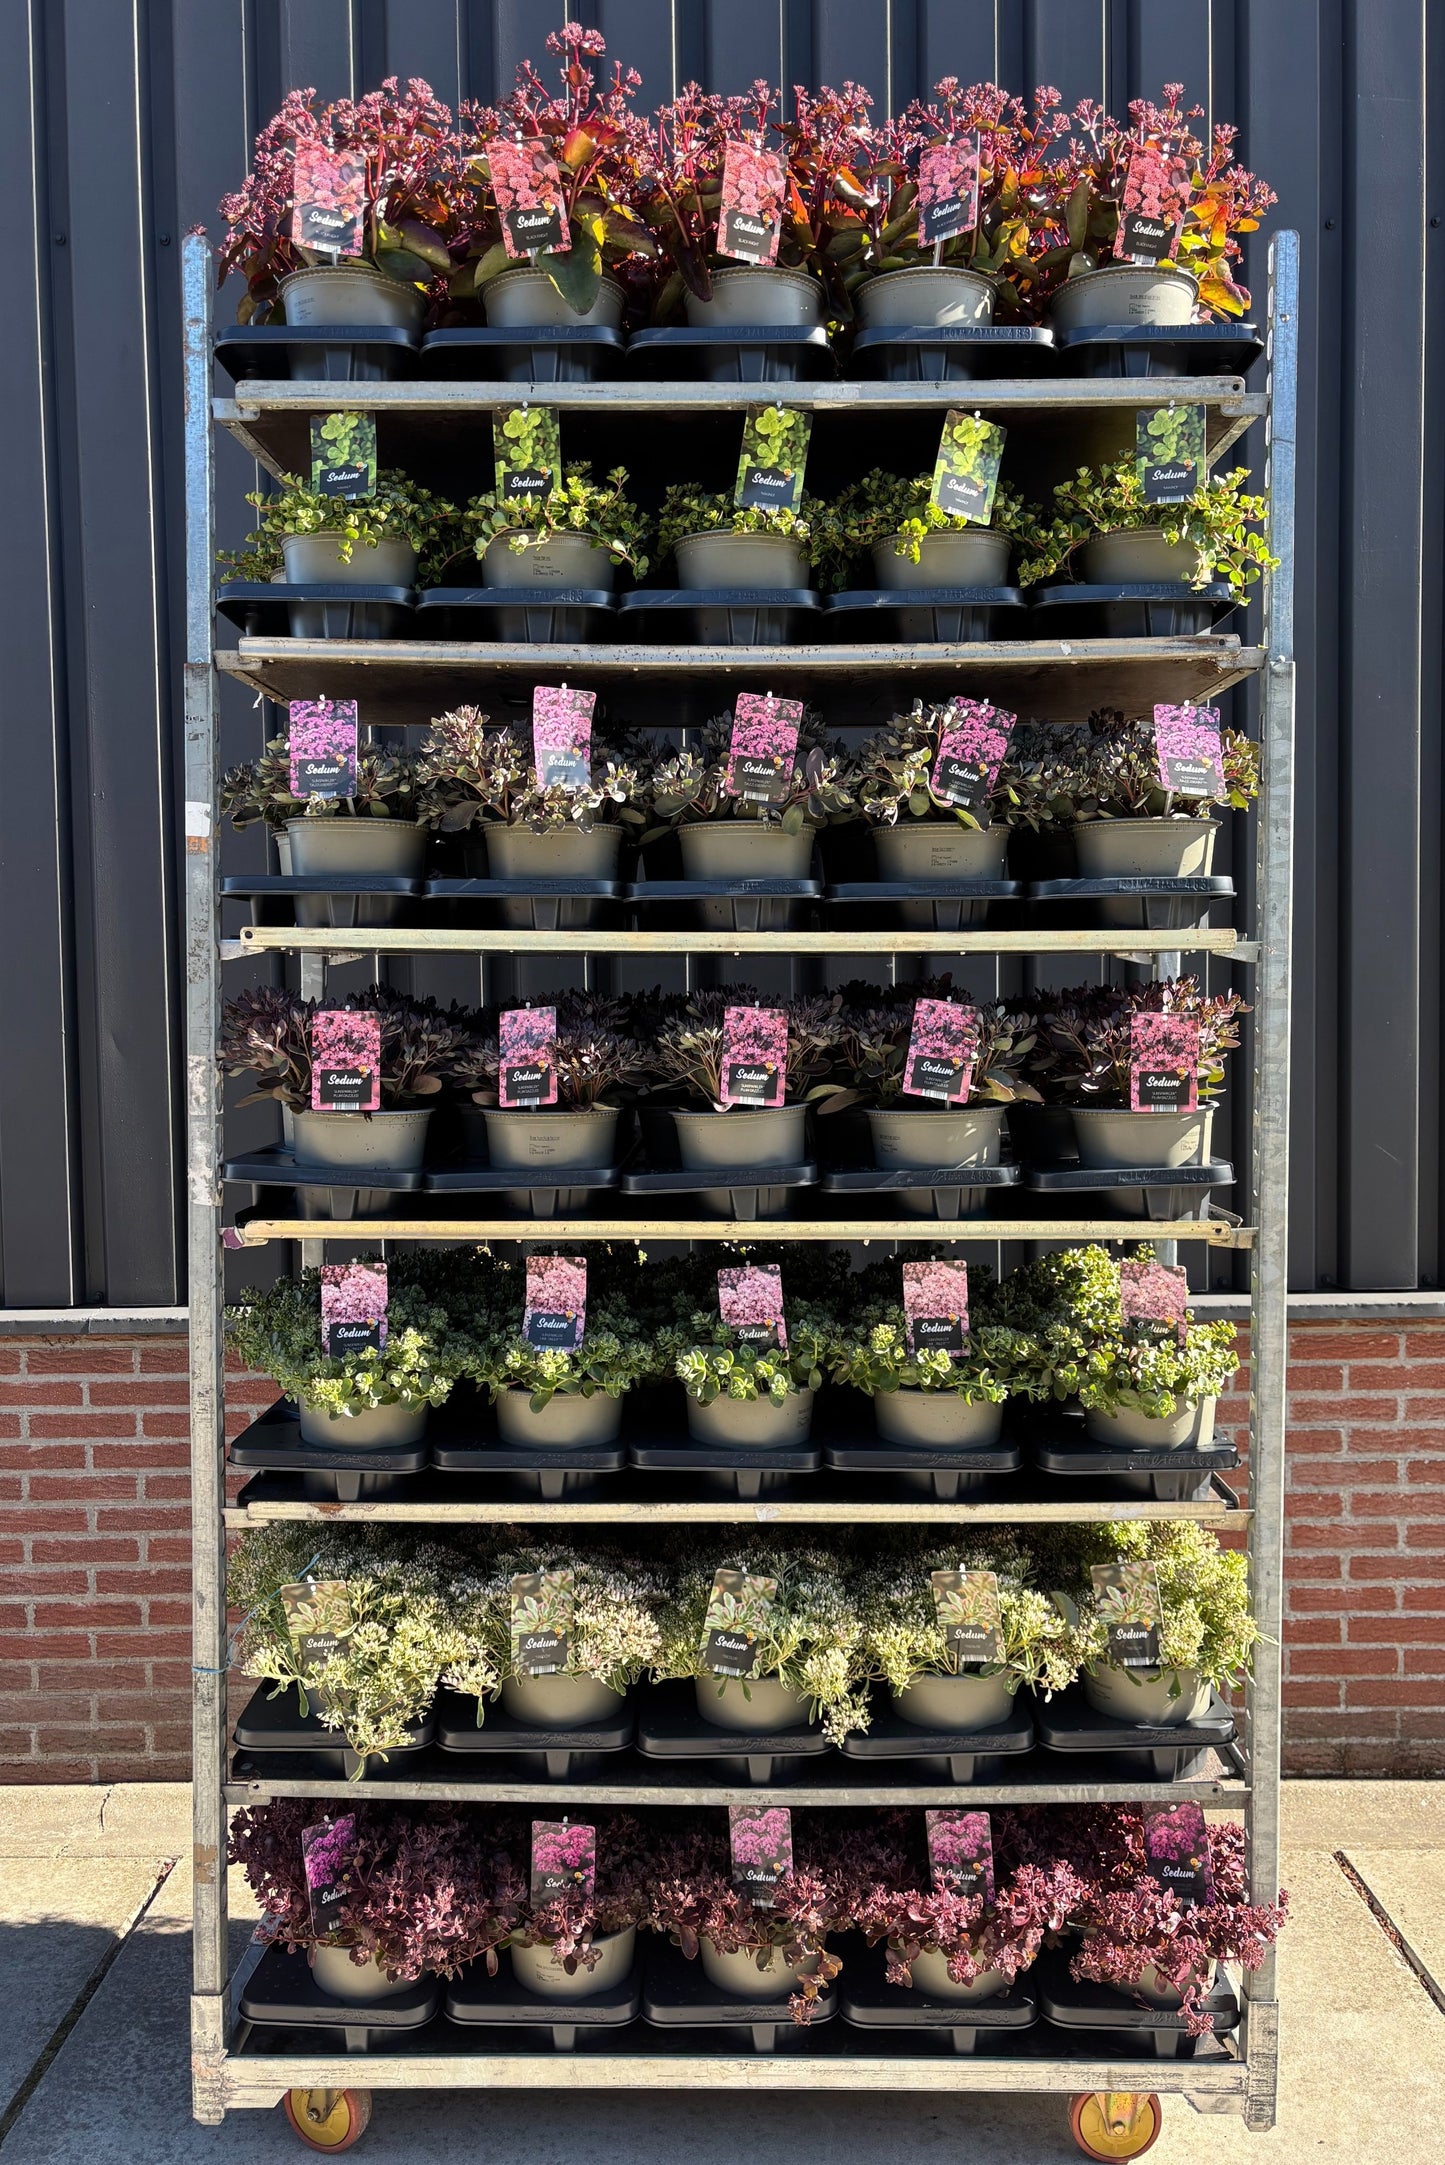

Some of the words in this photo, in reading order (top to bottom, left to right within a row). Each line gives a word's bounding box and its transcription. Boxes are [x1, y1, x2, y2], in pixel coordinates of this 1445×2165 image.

[931, 202, 962, 219] Sedum
[309, 211, 347, 229] Sedum
[516, 214, 551, 229] Sedum
[733, 218, 766, 236] Sedum
[1132, 221, 1166, 238] Sedum
[326, 472, 361, 483] Sedum
[510, 476, 545, 488] Sedum
[751, 472, 787, 488] Sedum
[1152, 470, 1188, 481] Sedum
[947, 479, 979, 497] Sedum
[547, 754, 577, 768] Sedum
[305, 763, 340, 775] Sedum
[742, 761, 777, 776] Sedum
[948, 763, 981, 782] Sedum
[1173, 762, 1208, 775] Sedum
[735, 1068, 769, 1081] Sedum
[920, 1061, 955, 1076] Sedum
[327, 1074, 363, 1085] Sedum
[512, 1071, 542, 1082] Sedum
[1146, 1076, 1181, 1087] Sedum
[536, 1317, 569, 1330] Sedum
[920, 1323, 953, 1334] Sedum
[1135, 1321, 1171, 1334] Sdum
[336, 1327, 371, 1339] Sedum
[737, 1329, 770, 1340] Sedum
[954, 1629, 989, 1640] Sedum
[1115, 1628, 1149, 1640] Sedum
[306, 1638, 340, 1649] Sedum
[525, 1638, 559, 1650] Sedum
[715, 1635, 749, 1651] Sedum
[746, 1869, 778, 1883] Sedum
[1162, 1865, 1196, 1879] Sedum
